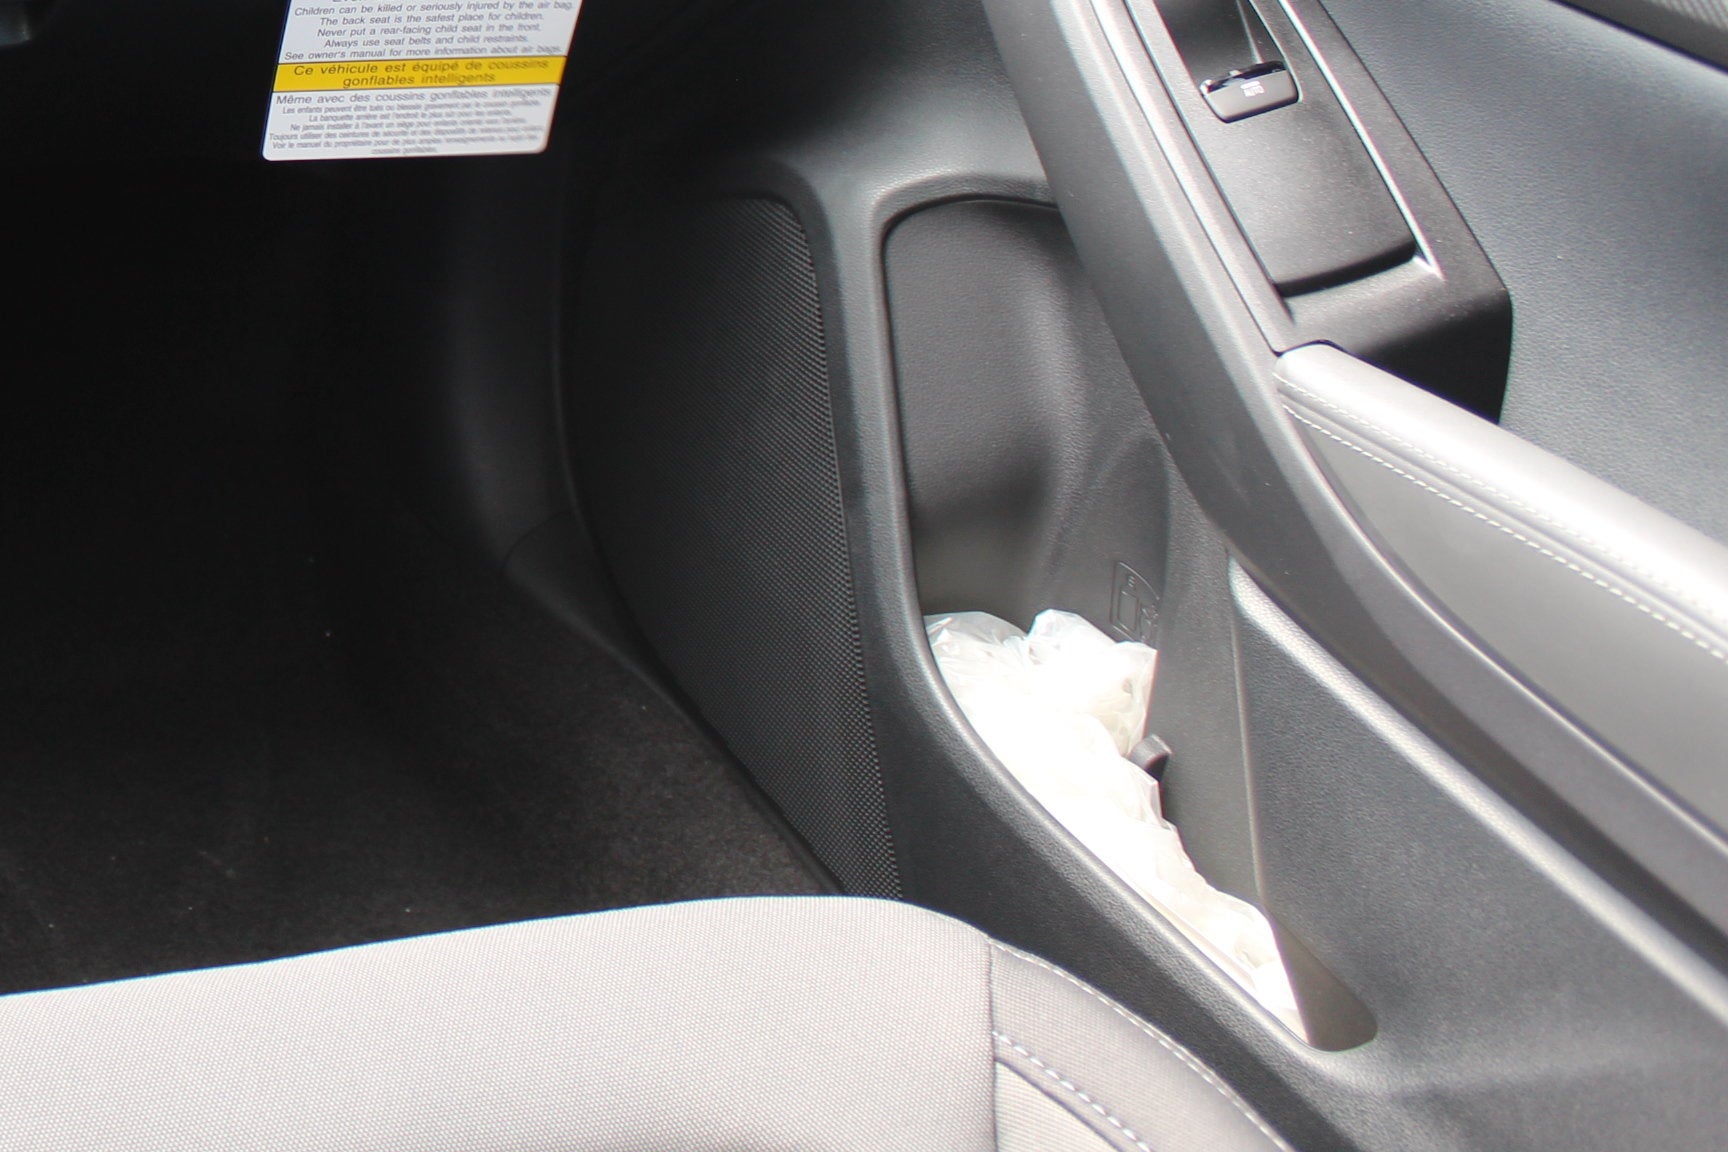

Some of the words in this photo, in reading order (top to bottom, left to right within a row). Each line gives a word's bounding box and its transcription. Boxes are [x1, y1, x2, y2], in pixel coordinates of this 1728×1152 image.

[294, 7, 335, 16] Children
[338, 7, 357, 15] can
[361, 5, 373, 13] be
[377, 4, 403, 12] killed
[420, 2, 463, 12] seriously
[467, 1, 499, 10] injured
[503, 1, 515, 11] by
[519, 0, 534, 8] the
[537, 0, 551, 8] air
[320, 17, 338, 26] The
[342, 16, 365, 25] back
[369, 15, 390, 24] seat
[394, 15, 402, 23] is
[407, 14, 421, 22] the
[425, 13, 455, 22] safest
[458, 13, 484, 23] place
[488, 12, 501, 21] for
[317, 28, 346, 37] Never
[350, 28, 366, 37] put
[369, 28, 376, 36] a
[380, 26, 431, 36] rear-facing
[435, 25, 458, 34] child
[461, 24, 482, 32] seat
[498, 23, 514, 31] the
[324, 39, 358, 48] Always
[362, 39, 380, 47] use
[384, 37, 405, 46] seat
[408, 36, 432, 45] belts
[435, 36, 453, 44] and
[457, 35, 480, 43] child
[284, 51, 304, 60] See
[308, 50, 346, 59] owner's
[349, 49, 386, 58] manual
[389, 48, 403, 57] for
[406, 48, 431, 56] more
[434, 46, 487, 55] information
[490, 45, 519, 54] about
[294, 65, 314, 76] Ce
[320, 62, 378, 75] véhicule
[384, 62, 407, 72] est
[412, 59, 459, 73] équipé
[465, 60, 482, 70] de
[488, 59, 550, 70] coussins
[343, 74, 415, 89] gonflables
[421, 72, 496, 86] intelligents
[276, 94, 312, 105] Même
[317, 95, 345, 104] avec
[349, 93, 371, 103] des
[375, 91, 426, 103] coussins
